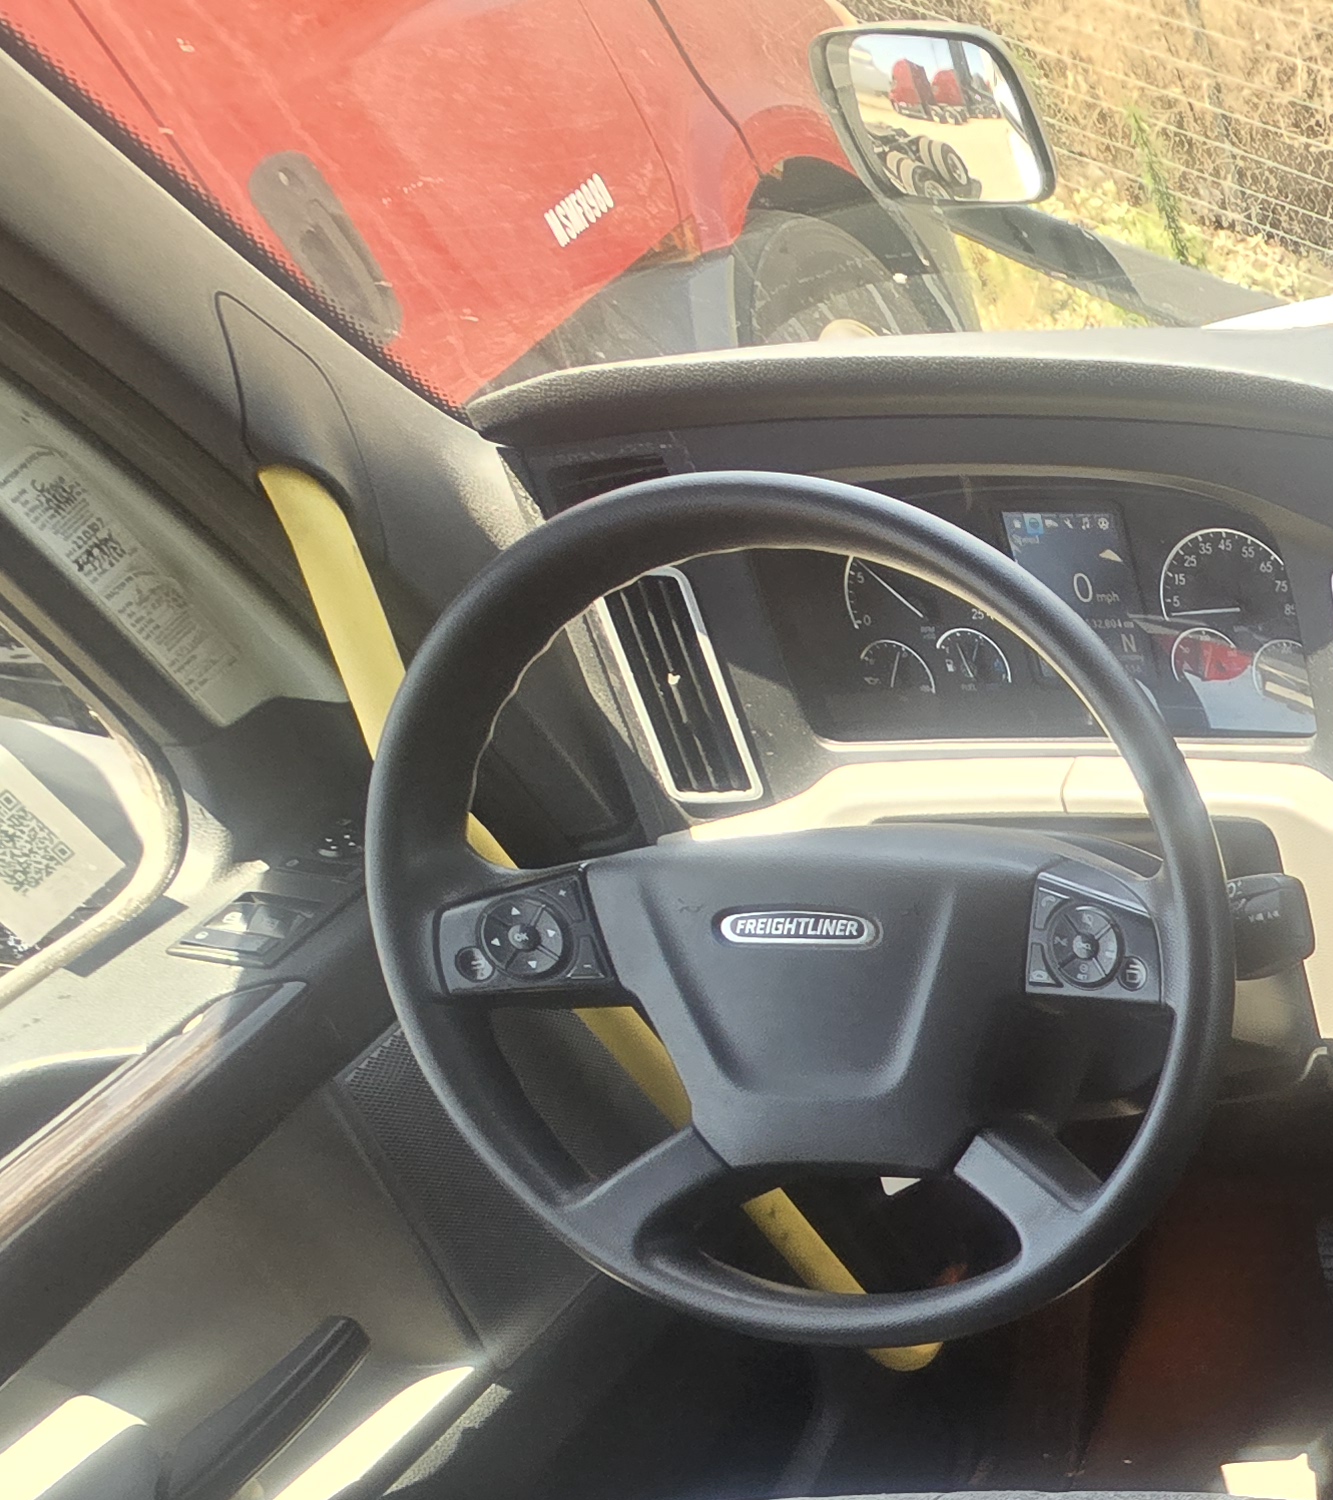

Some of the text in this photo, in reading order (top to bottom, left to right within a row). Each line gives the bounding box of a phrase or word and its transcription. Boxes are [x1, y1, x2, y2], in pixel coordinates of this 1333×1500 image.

[1199, 543, 1212, 555] 35
[1218, 539, 1232, 551] 45
[1241, 546, 1255, 558] 55
[1184, 555, 1197, 567] 25
[1260, 561, 1273, 573] 65
[857, 572, 865, 584] 5
[1174, 574, 1186, 585] 15
[1073, 573, 1120, 604] 0 mph
[1275, 580, 1288, 592] 75
[1172, 596, 1180, 607] 5
[971, 608, 985, 620] 25
[863, 615, 872, 626] 0
[1121, 634, 1137, 653] N
[736, 917, 858, 936] FREIGHTLINER
[514, 932, 530, 942] OK
